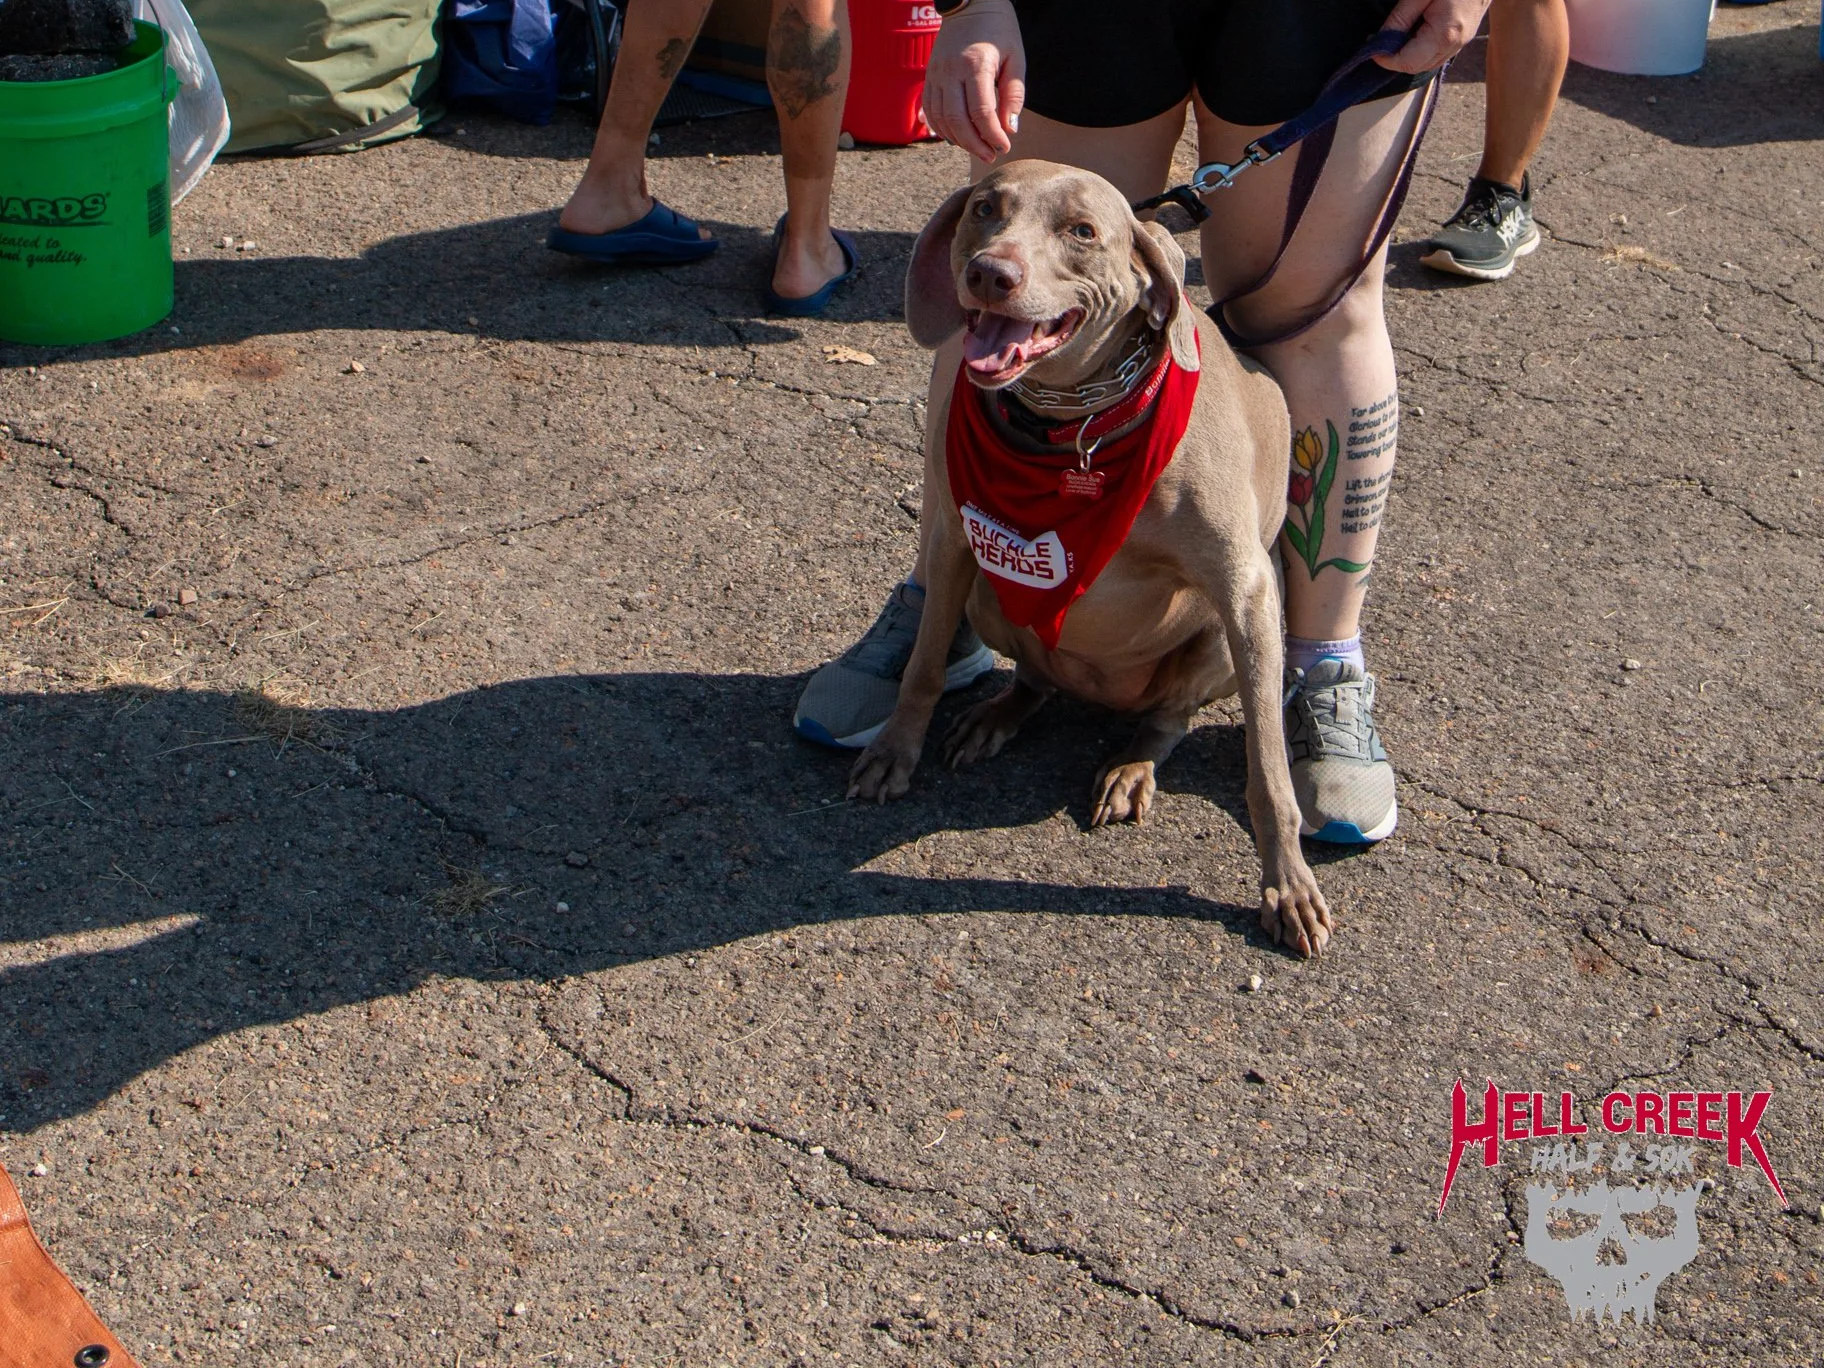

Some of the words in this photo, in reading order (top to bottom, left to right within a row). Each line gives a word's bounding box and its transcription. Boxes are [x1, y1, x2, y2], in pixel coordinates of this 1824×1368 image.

[0, 193, 107, 221] ARDS
[1497, 205, 1525, 249] HOKA
[46, 237, 60, 249] to
[26, 248, 88, 268] quality.
[1351, 408, 1367, 417] Far
[1369, 400, 1387, 414] above
[1349, 417, 1381, 432] Glorious
[1347, 432, 1376, 446] Stands
[1346, 445, 1381, 460] Towering
[1345, 479, 1362, 491] Lift
[1363, 477, 1376, 488] the
[1342, 507, 1359, 518] Hail
[1361, 506, 1370, 516] to
[1341, 522, 1358, 533] Hail
[1359, 522, 1368, 531] to
[969, 518, 1051, 558] BUCKLE
[972, 535, 1054, 580] HEADS
